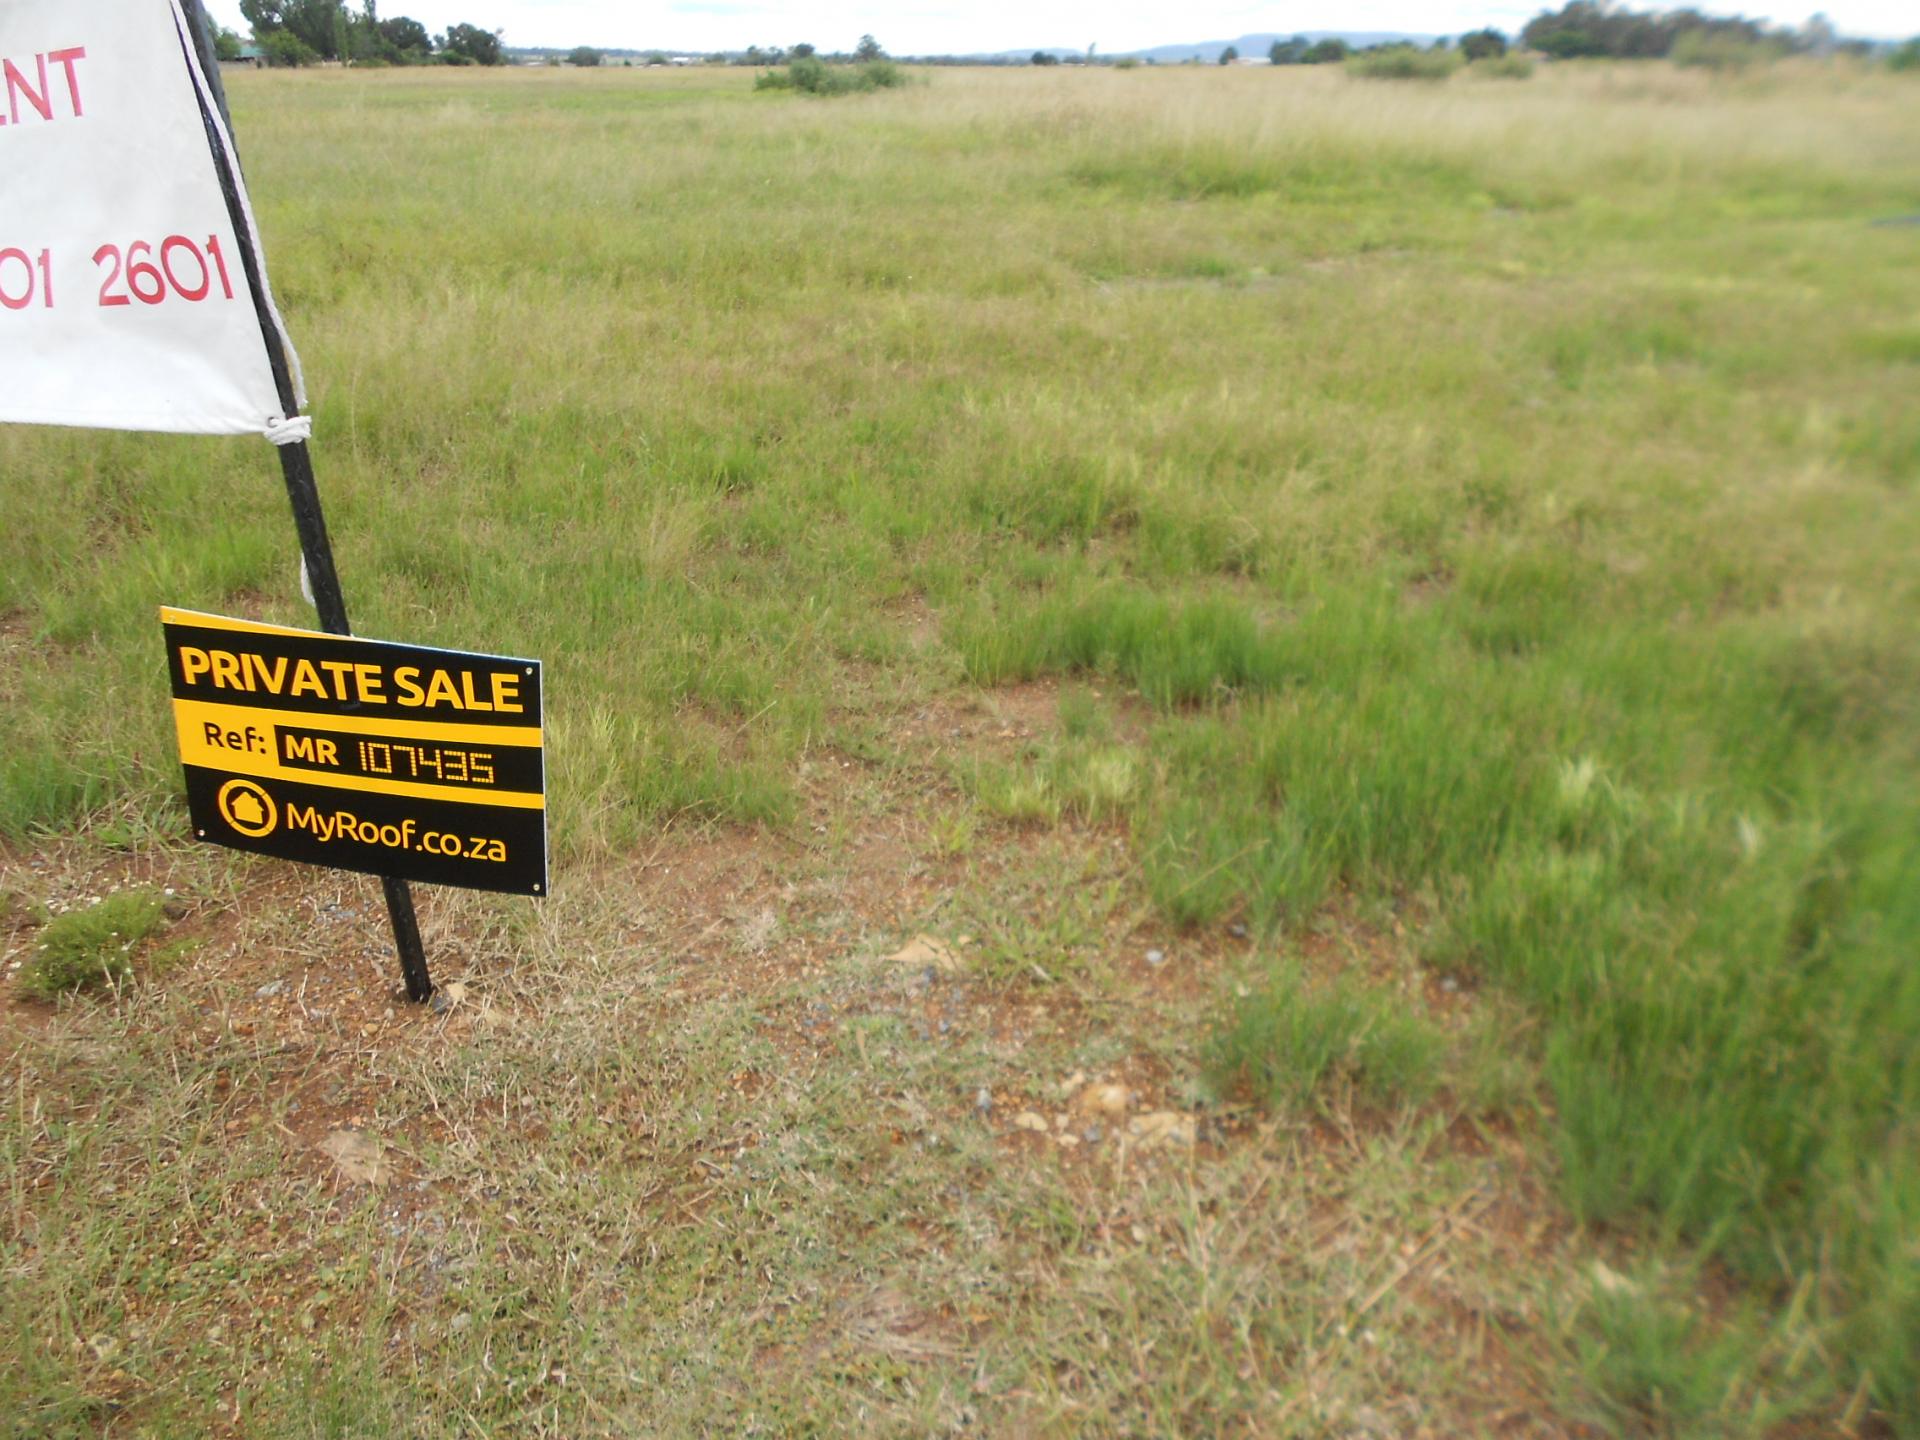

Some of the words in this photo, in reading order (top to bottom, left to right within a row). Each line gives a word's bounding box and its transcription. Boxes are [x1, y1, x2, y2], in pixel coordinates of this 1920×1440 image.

[0, 46, 86, 126] NT
[91, 234, 234, 306] 2601
[179, 646, 388, 705] PRIVATE
[393, 666, 524, 714] SALE
[203, 721, 267, 754] Ref:
[284, 734, 340, 766] MR
[358, 740, 495, 784] 107435
[286, 802, 507, 862] MyRoof.co.za
